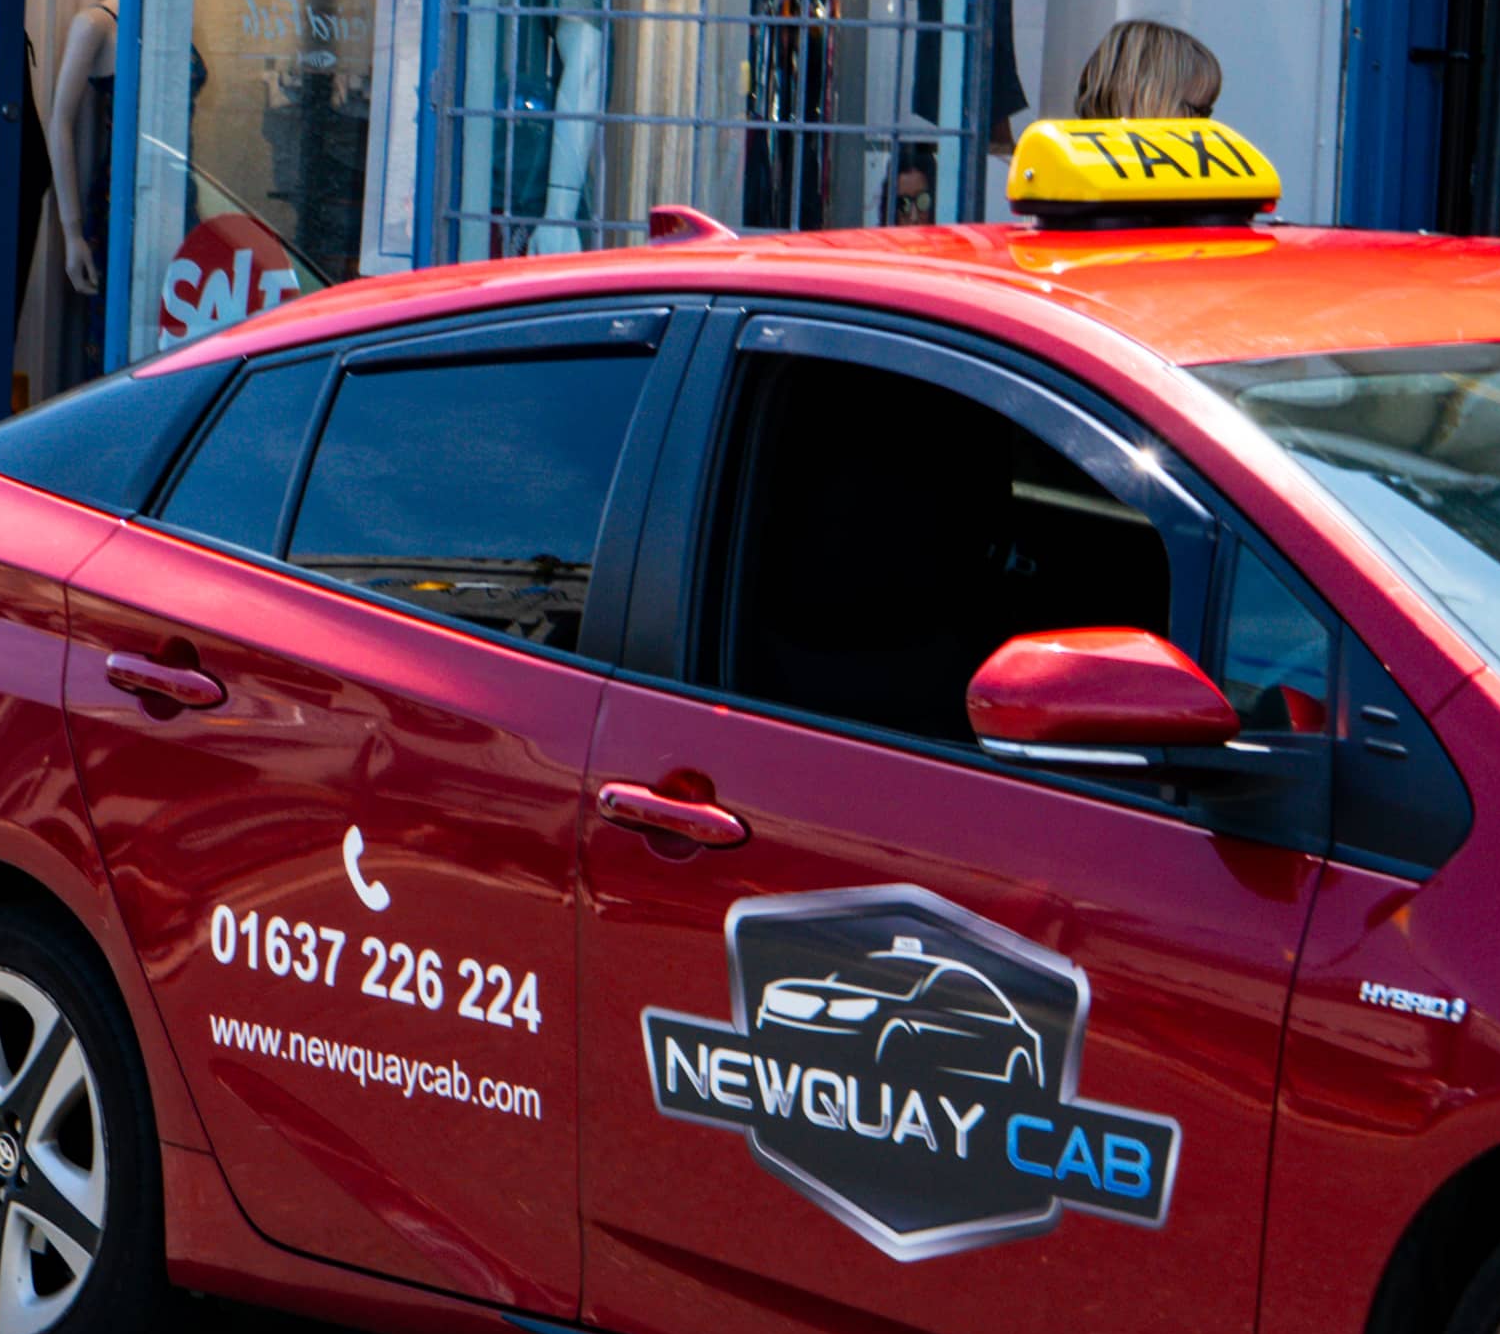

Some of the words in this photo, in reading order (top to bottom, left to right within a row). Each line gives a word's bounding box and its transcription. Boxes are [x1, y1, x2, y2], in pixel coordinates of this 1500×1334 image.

[1069, 130, 1257, 180] TAXI
[210, 904, 346, 988] 01637
[360, 935, 446, 1011] 226
[457, 958, 543, 1035] 224
[209, 1013, 543, 1121] www.newquaycab.com
[664, 1035, 986, 1160] NEWQUAY
[1006, 1112, 1153, 1199] CAB
